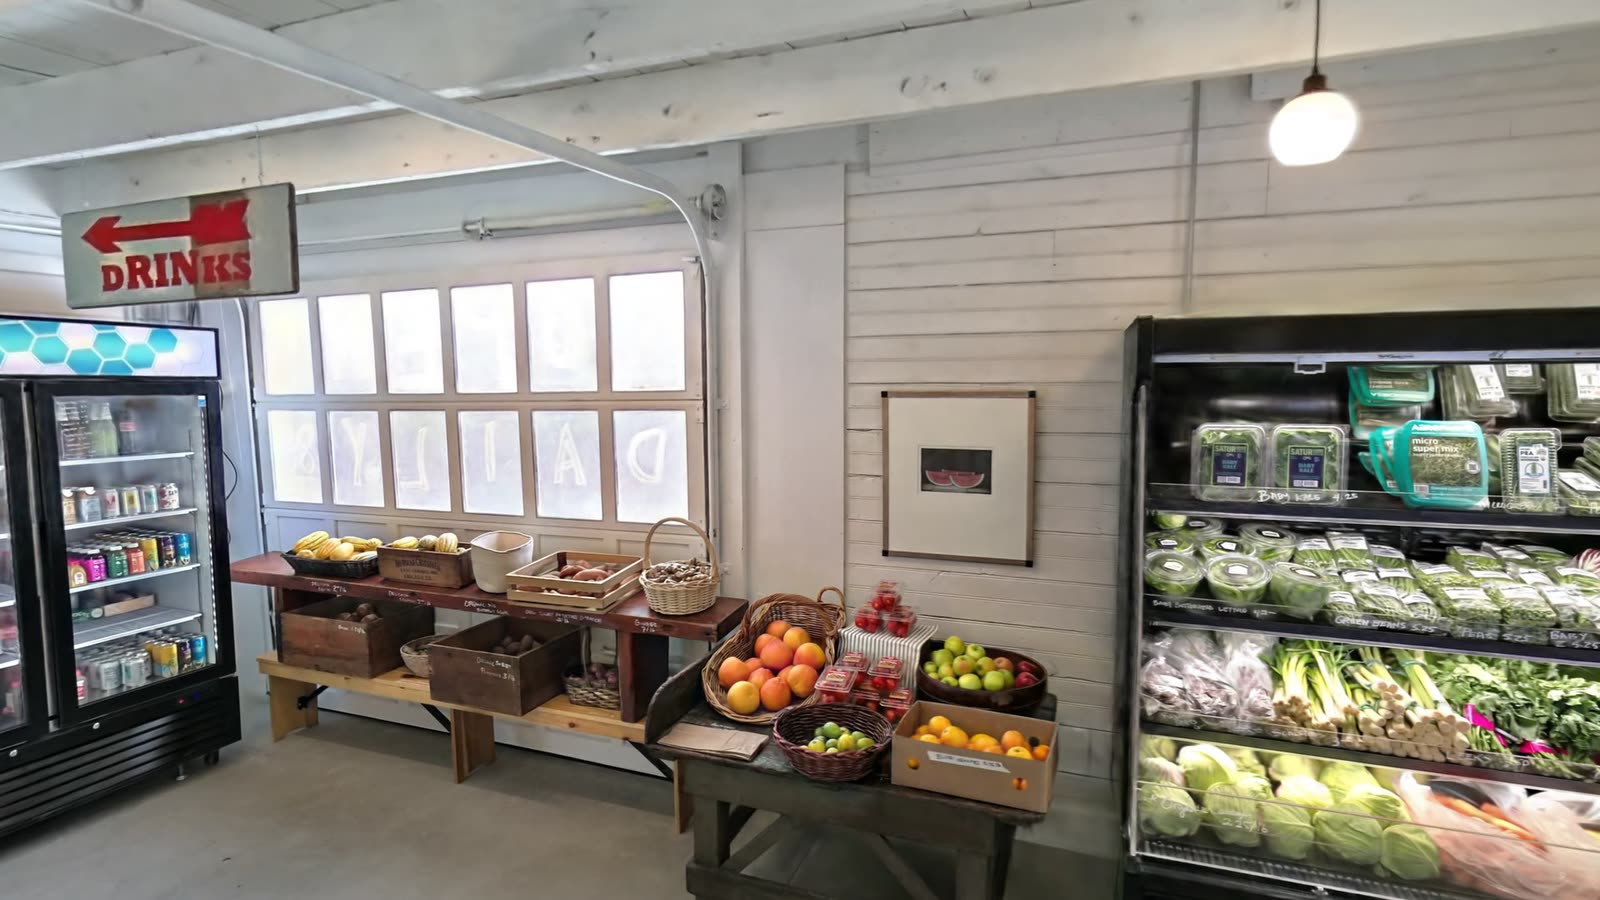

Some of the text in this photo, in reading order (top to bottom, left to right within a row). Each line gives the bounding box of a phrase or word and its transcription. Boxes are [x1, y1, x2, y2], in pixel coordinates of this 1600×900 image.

[101, 249, 252, 292] DRINKS
[1412, 437, 1438, 445] micro
[1290, 448, 1313, 456] SATUR
[1412, 445, 1459, 455] super mix
